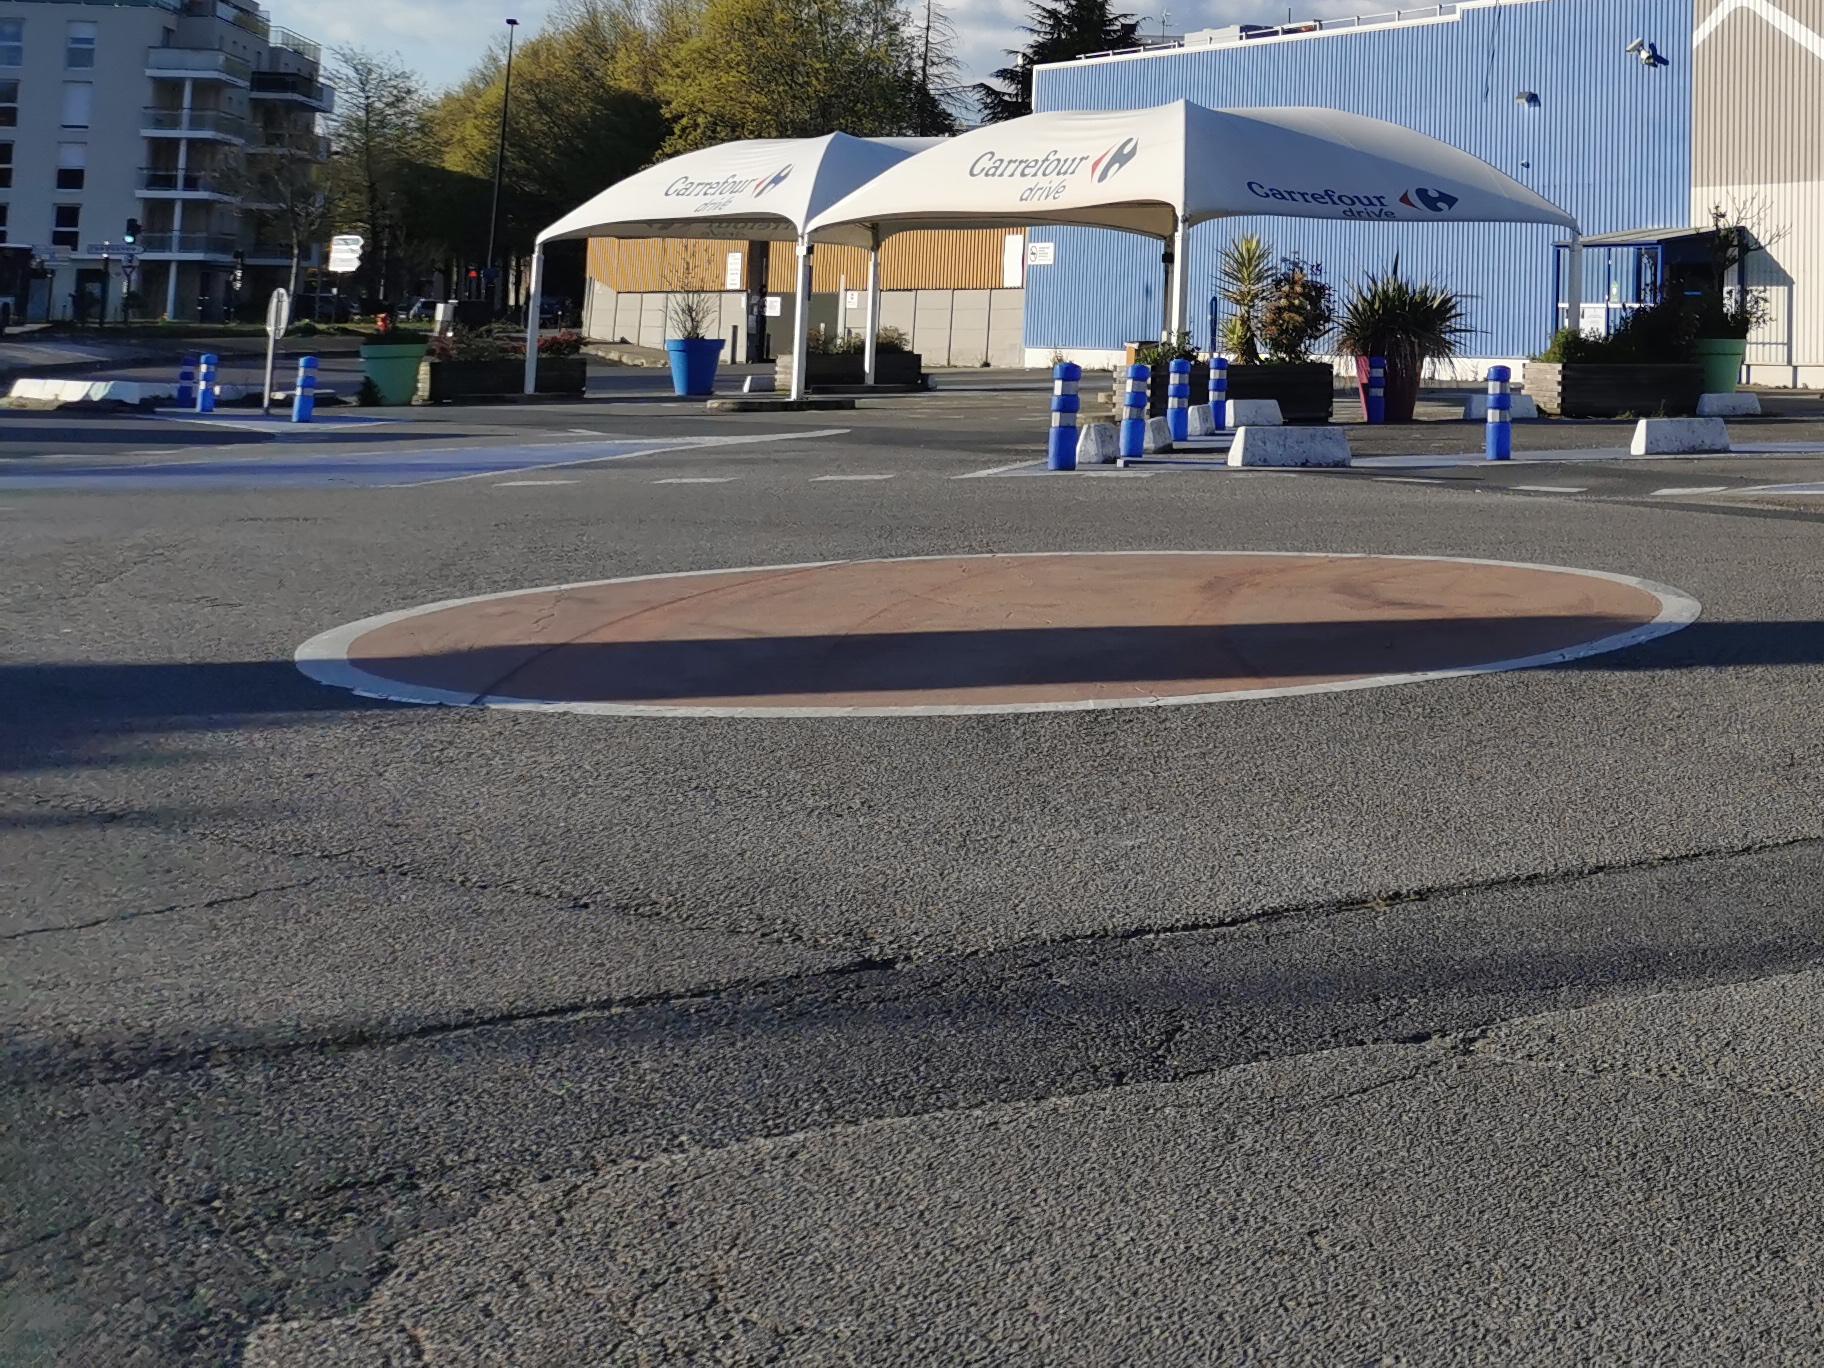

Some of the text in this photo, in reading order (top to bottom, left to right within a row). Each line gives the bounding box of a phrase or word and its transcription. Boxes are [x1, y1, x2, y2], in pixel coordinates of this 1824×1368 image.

[968, 149, 1090, 178] Carrefour
[664, 174, 758, 197] Carrefour
[1019, 179, 1066, 202] drive
[1246, 181, 1389, 207] Carrefour
[693, 196, 734, 212] drive
[1342, 207, 1397, 219] drive
